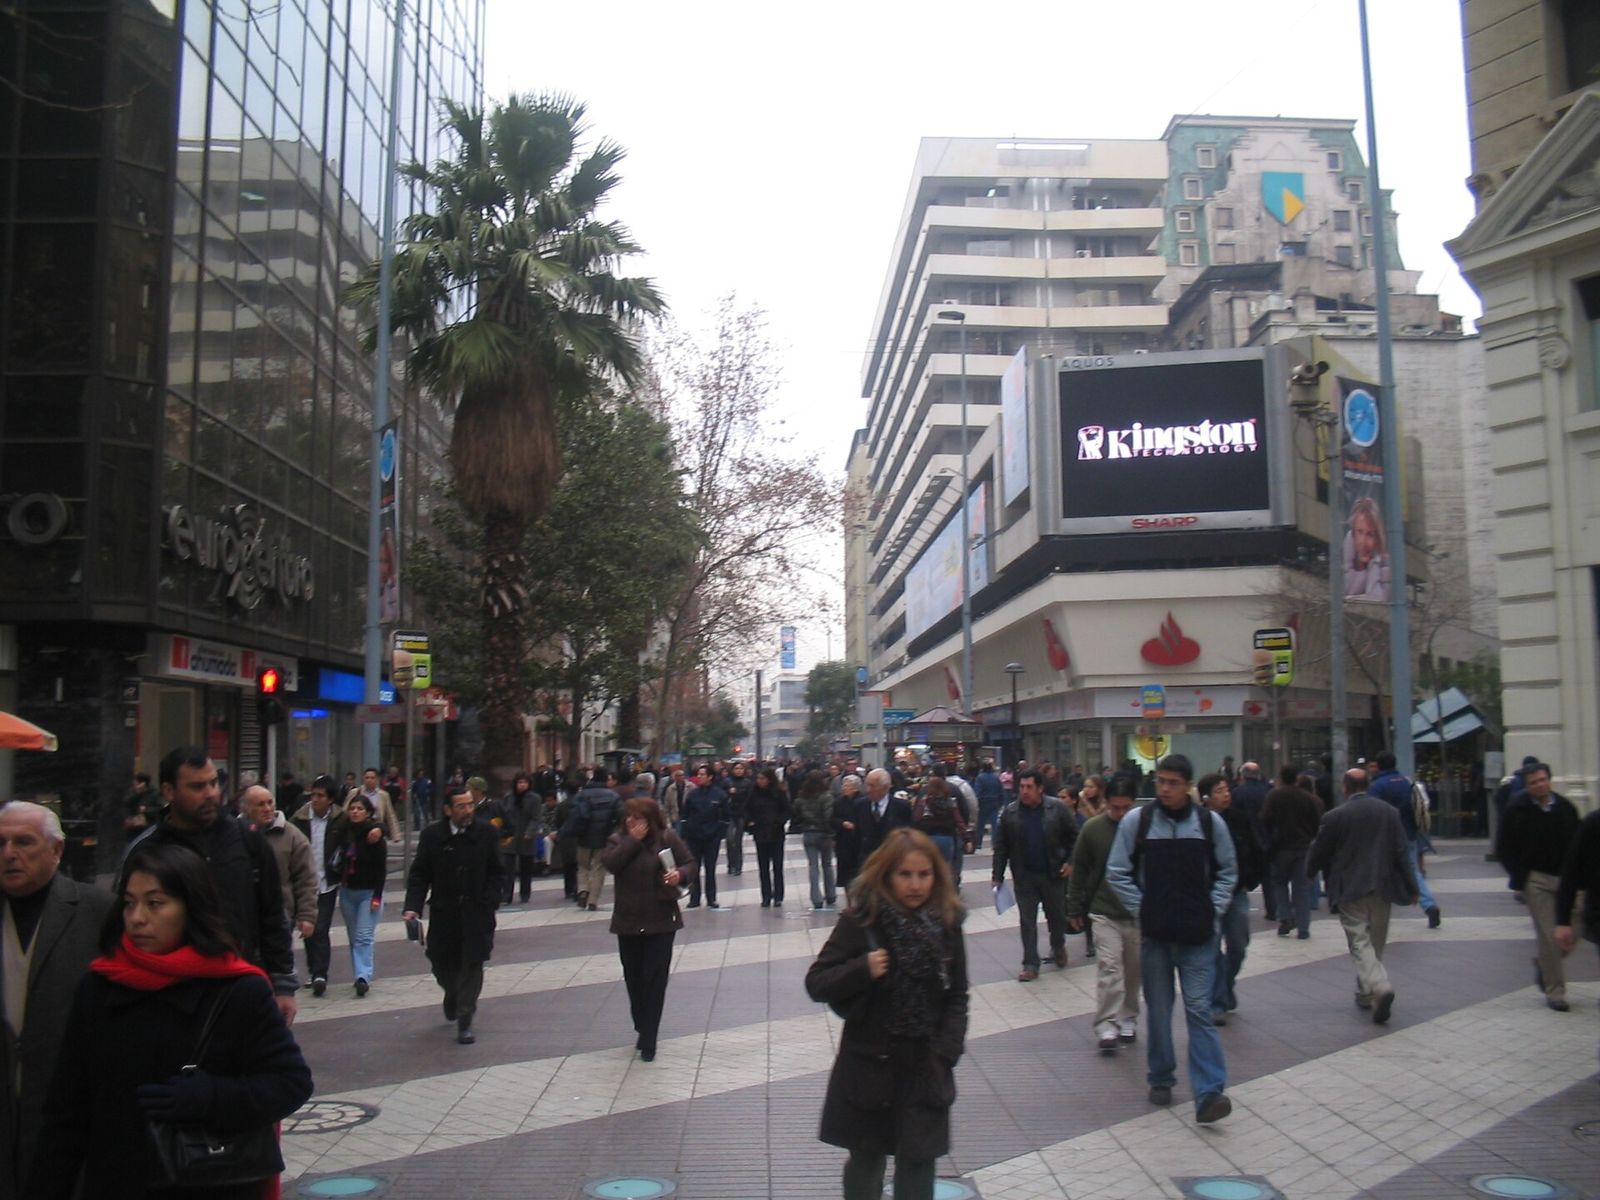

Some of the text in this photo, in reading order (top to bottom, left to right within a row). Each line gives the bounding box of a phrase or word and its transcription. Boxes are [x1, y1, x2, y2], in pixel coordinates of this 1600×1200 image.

[1061, 356, 1116, 369] AQUOS
[1107, 418, 1257, 459] Kingston
[1133, 444, 1258, 458] TECHNOLOGY
[1131, 516, 1199, 529] SHARP
